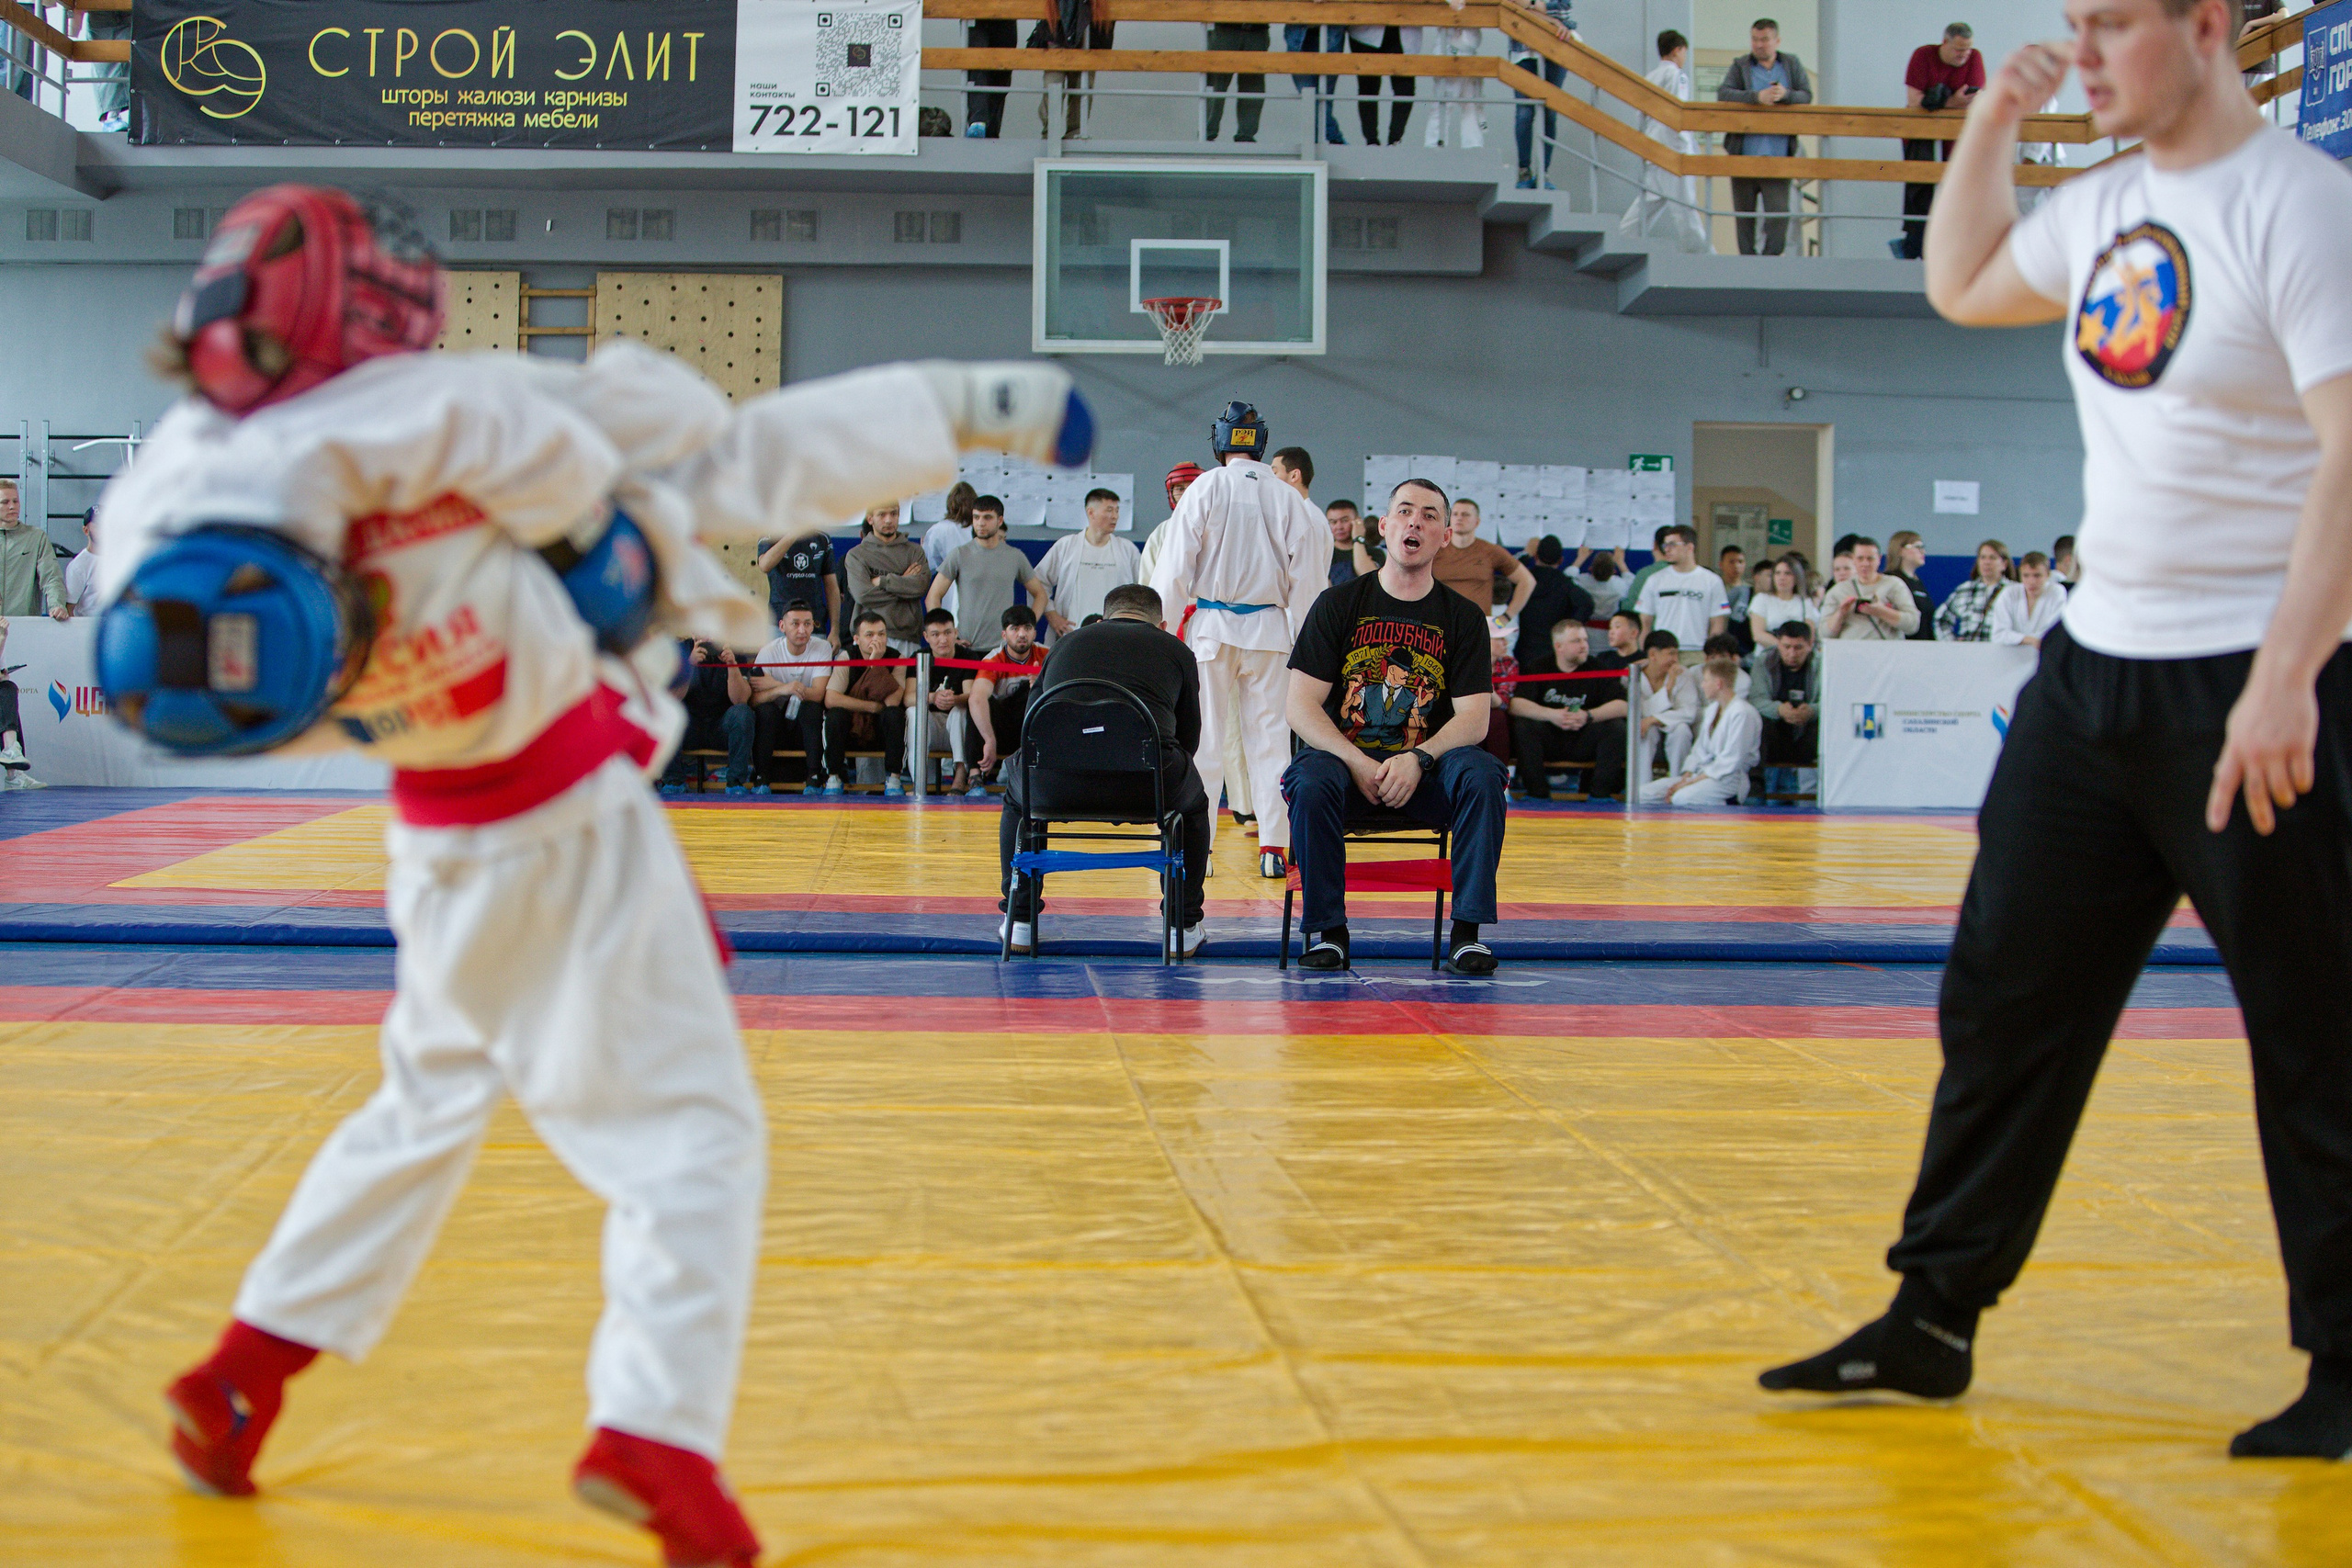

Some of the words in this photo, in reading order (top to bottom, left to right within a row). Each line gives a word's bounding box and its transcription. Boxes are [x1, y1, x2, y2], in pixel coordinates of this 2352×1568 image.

[308, 26, 516, 79] СТРОЙ
[554, 29, 706, 82] ЭЛИТ
[381, 88, 448, 109] шторы
[457, 89, 536, 107] жалюзи
[544, 90, 628, 111] карнизы
[408, 111, 516, 131] перетяжка
[523, 107, 599, 129] мебели
[786, 571, 816, 580] crypto.com
[1351, 621, 1445, 660] ПОДДУБНЫЙ
[1351, 648, 1369, 662] 1871
[1423, 657, 1443, 675] 1949
[75, 686, 109, 716] ЦС
